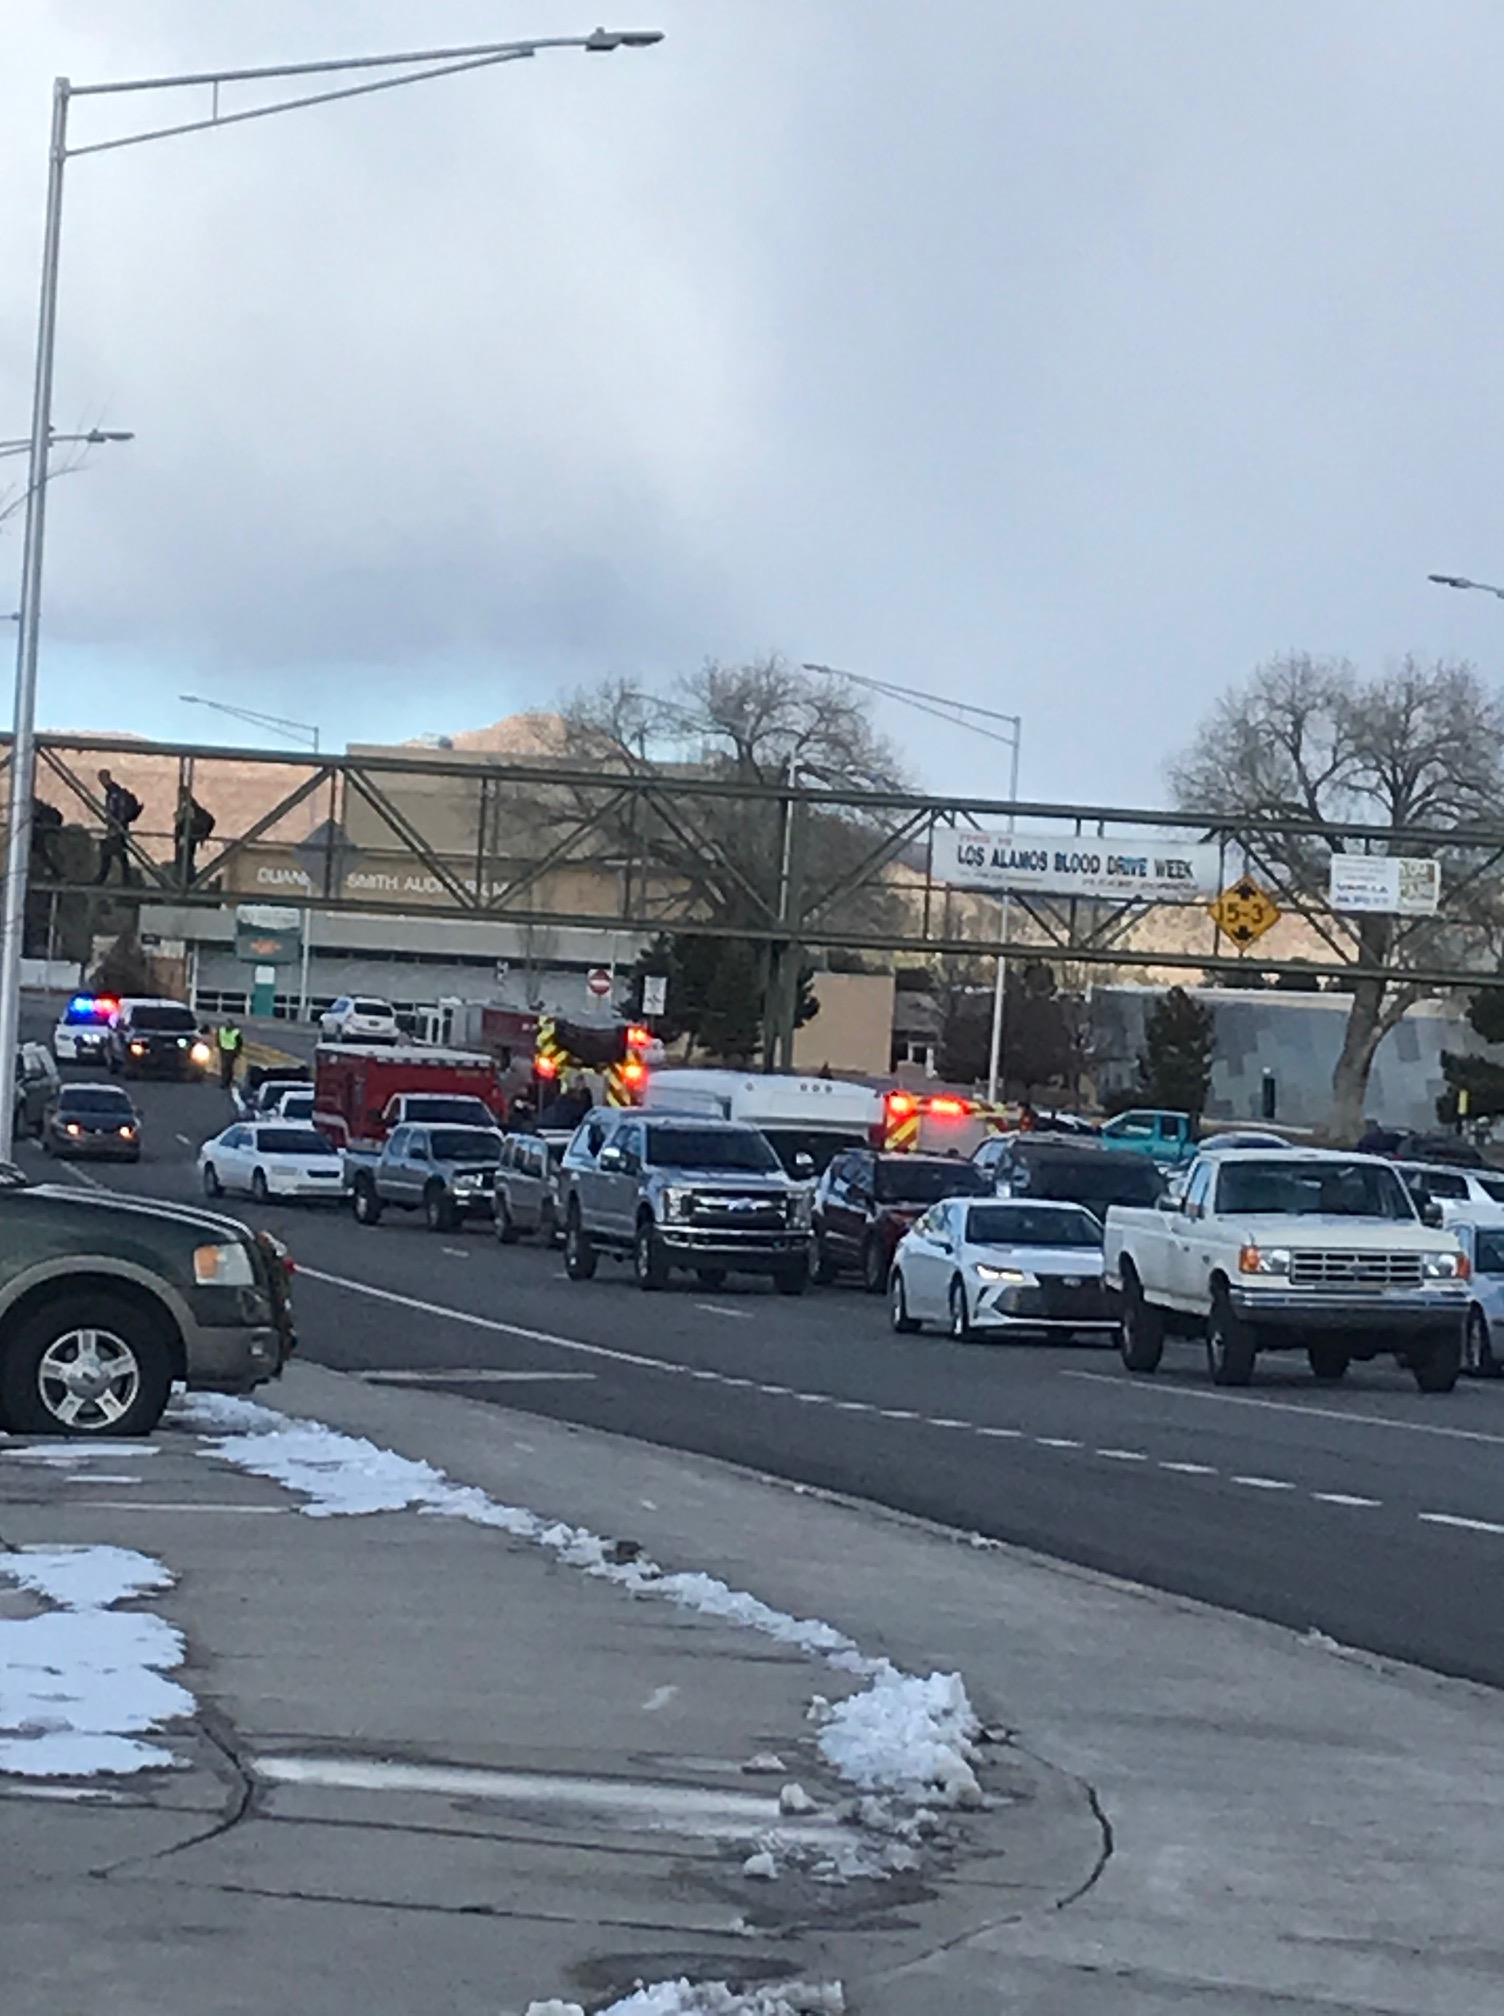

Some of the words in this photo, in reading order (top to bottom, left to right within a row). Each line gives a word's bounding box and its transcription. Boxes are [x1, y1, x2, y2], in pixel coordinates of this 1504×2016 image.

[957, 845, 985, 867] LOS
[990, 848, 1048, 872] ALAMOS
[1054, 852, 1101, 875] BLOOD
[1107, 855, 1148, 878] DRIVE
[1154, 858, 1195, 880] WEEK
